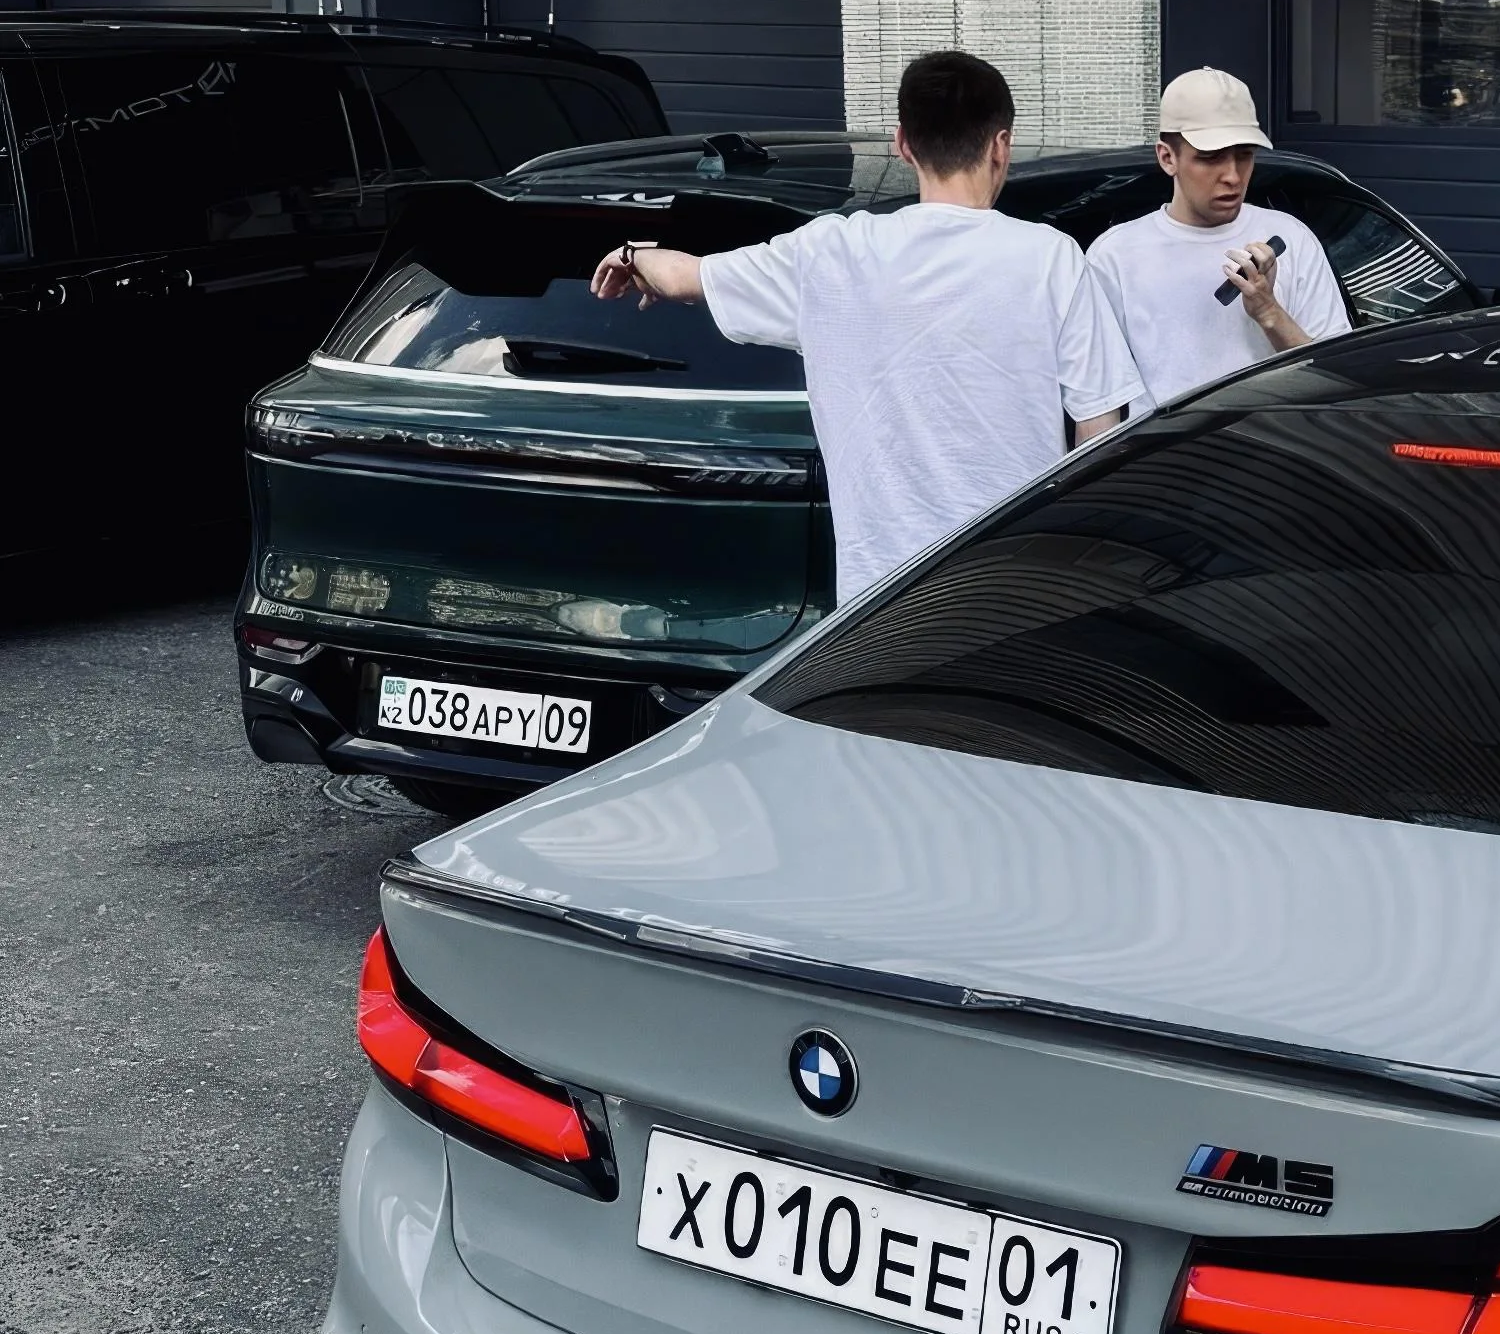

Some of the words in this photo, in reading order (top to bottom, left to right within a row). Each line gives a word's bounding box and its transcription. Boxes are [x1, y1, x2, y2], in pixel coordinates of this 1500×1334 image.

[408, 686, 536, 741] 038APY
[544, 702, 588, 747] 09
[1218, 1147, 1334, 1202] M5
[998, 1235, 1079, 1321] 01
